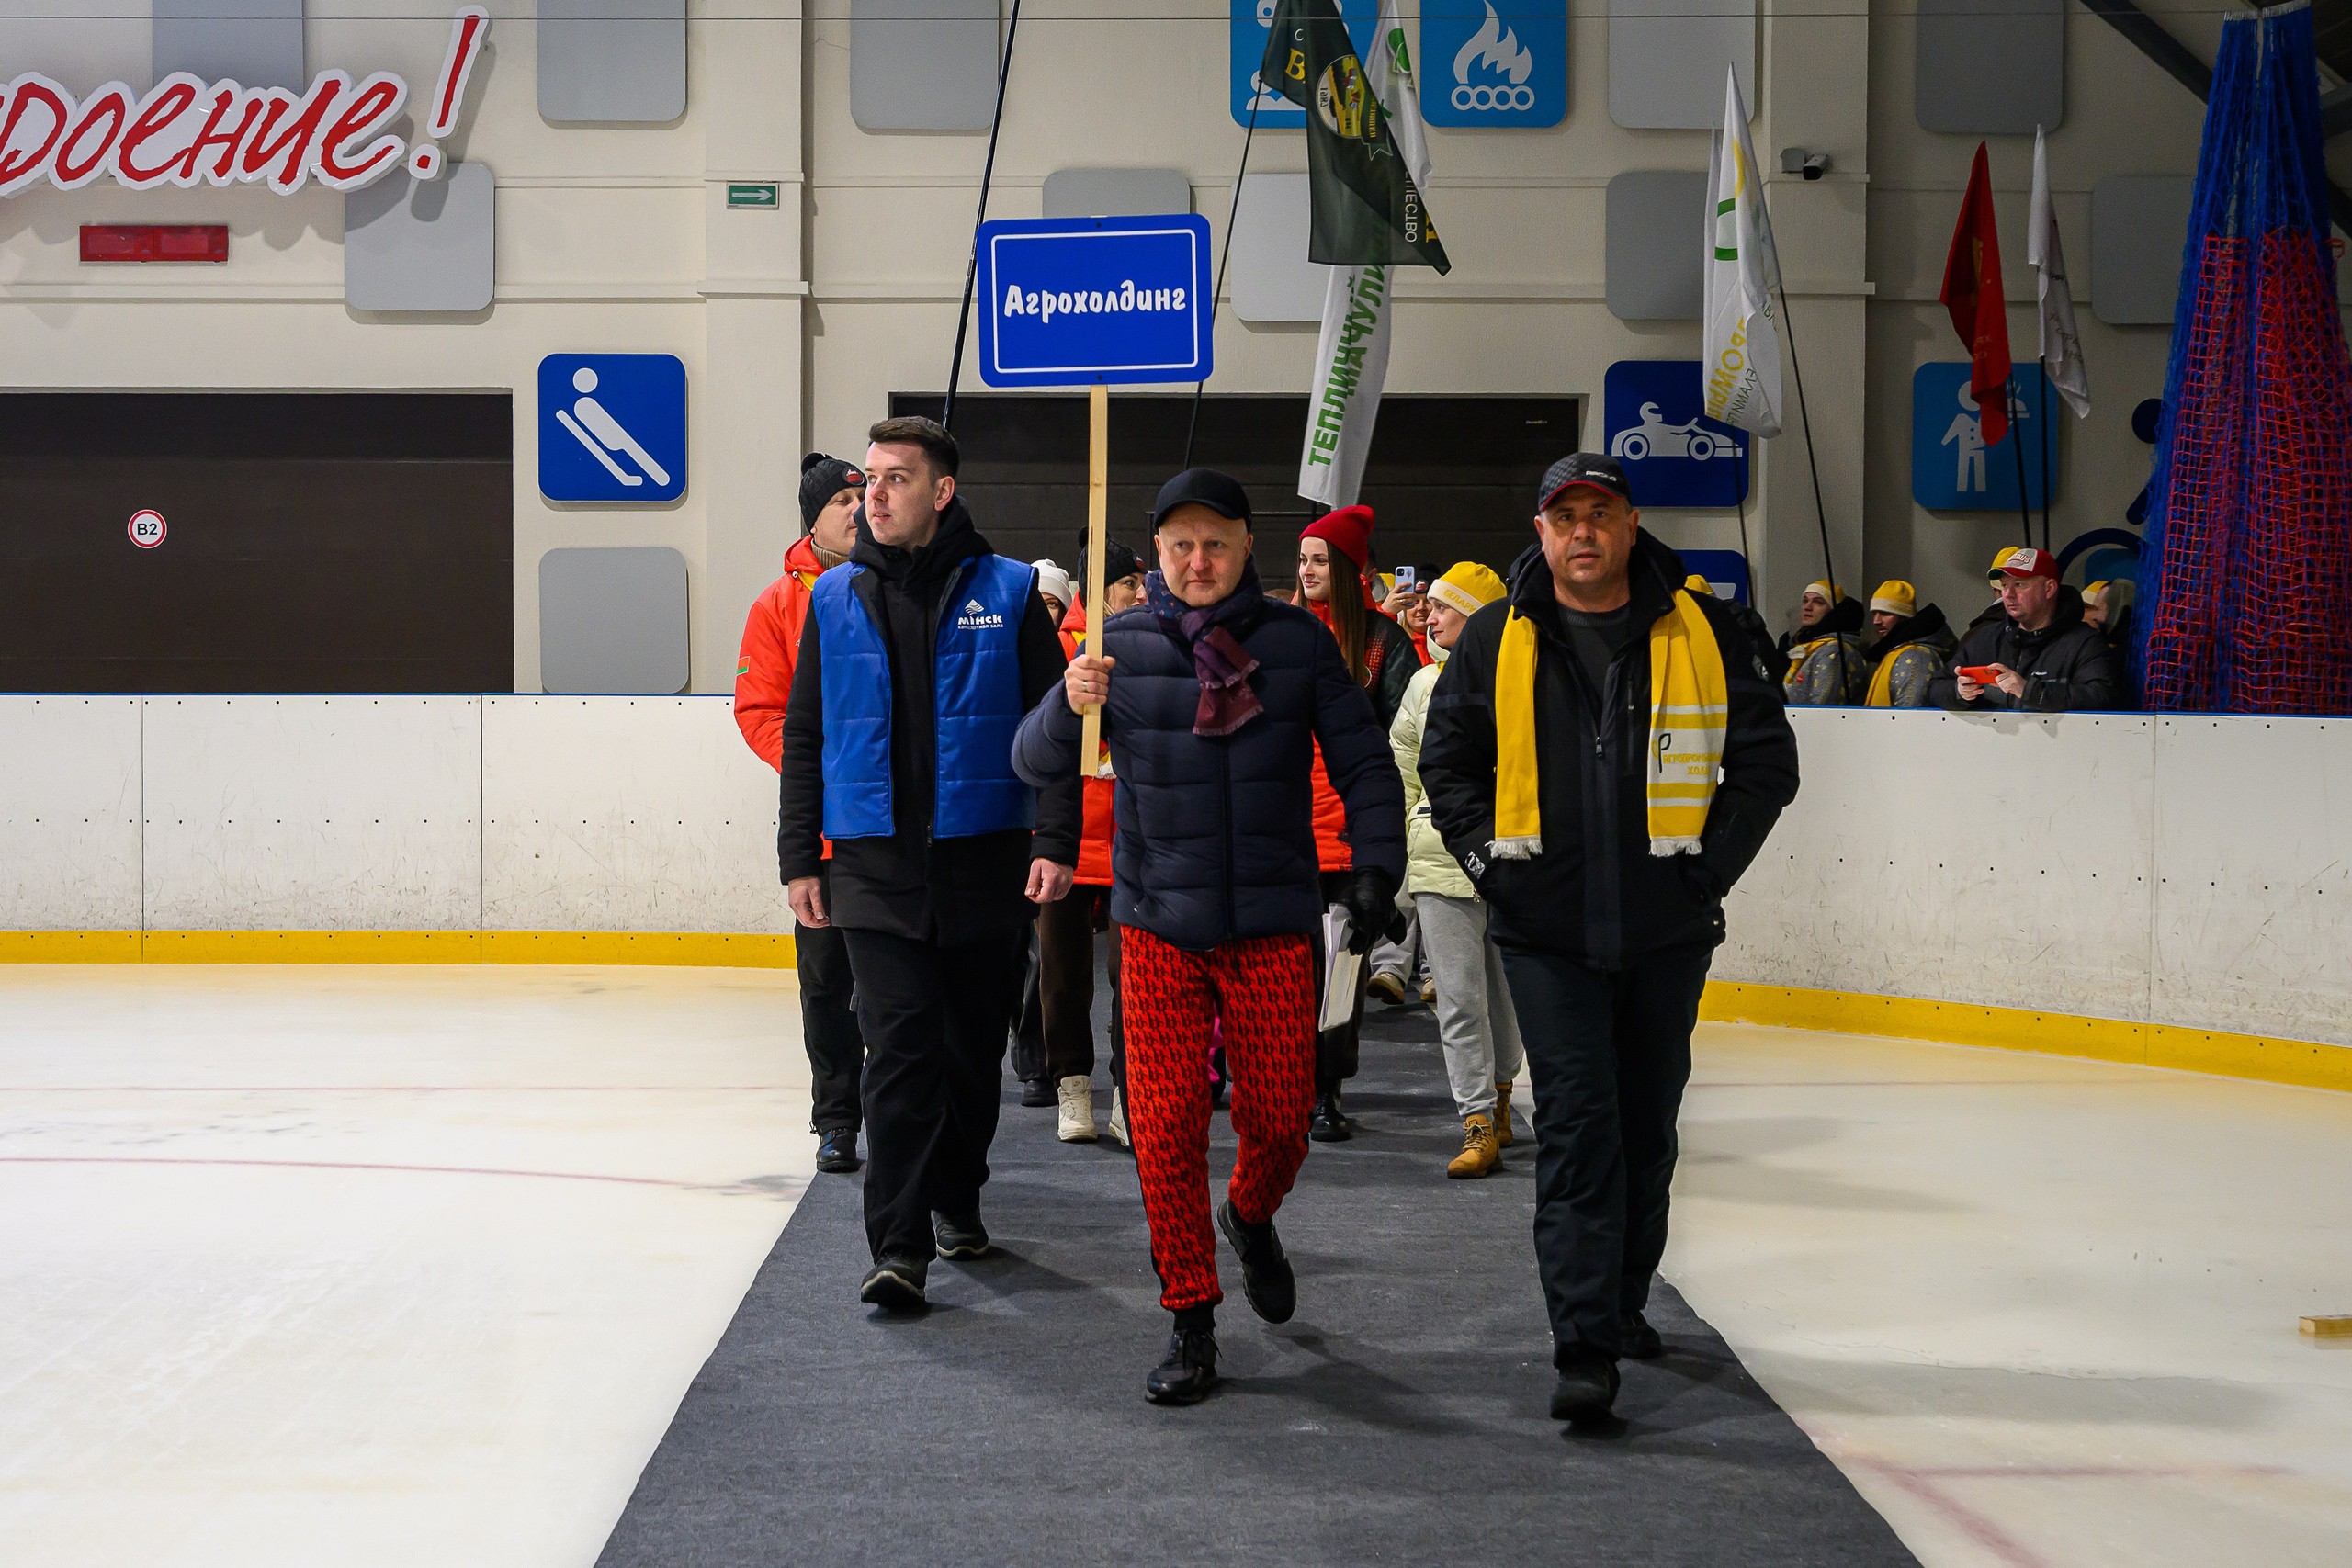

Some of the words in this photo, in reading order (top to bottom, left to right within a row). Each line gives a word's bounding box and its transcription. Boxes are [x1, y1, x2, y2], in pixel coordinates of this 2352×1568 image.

[0, 12, 484, 187] роение!
[1003, 279, 1186, 324] Агрохолдинг
[1443, 589, 1477, 613] БЕЛАРУ
